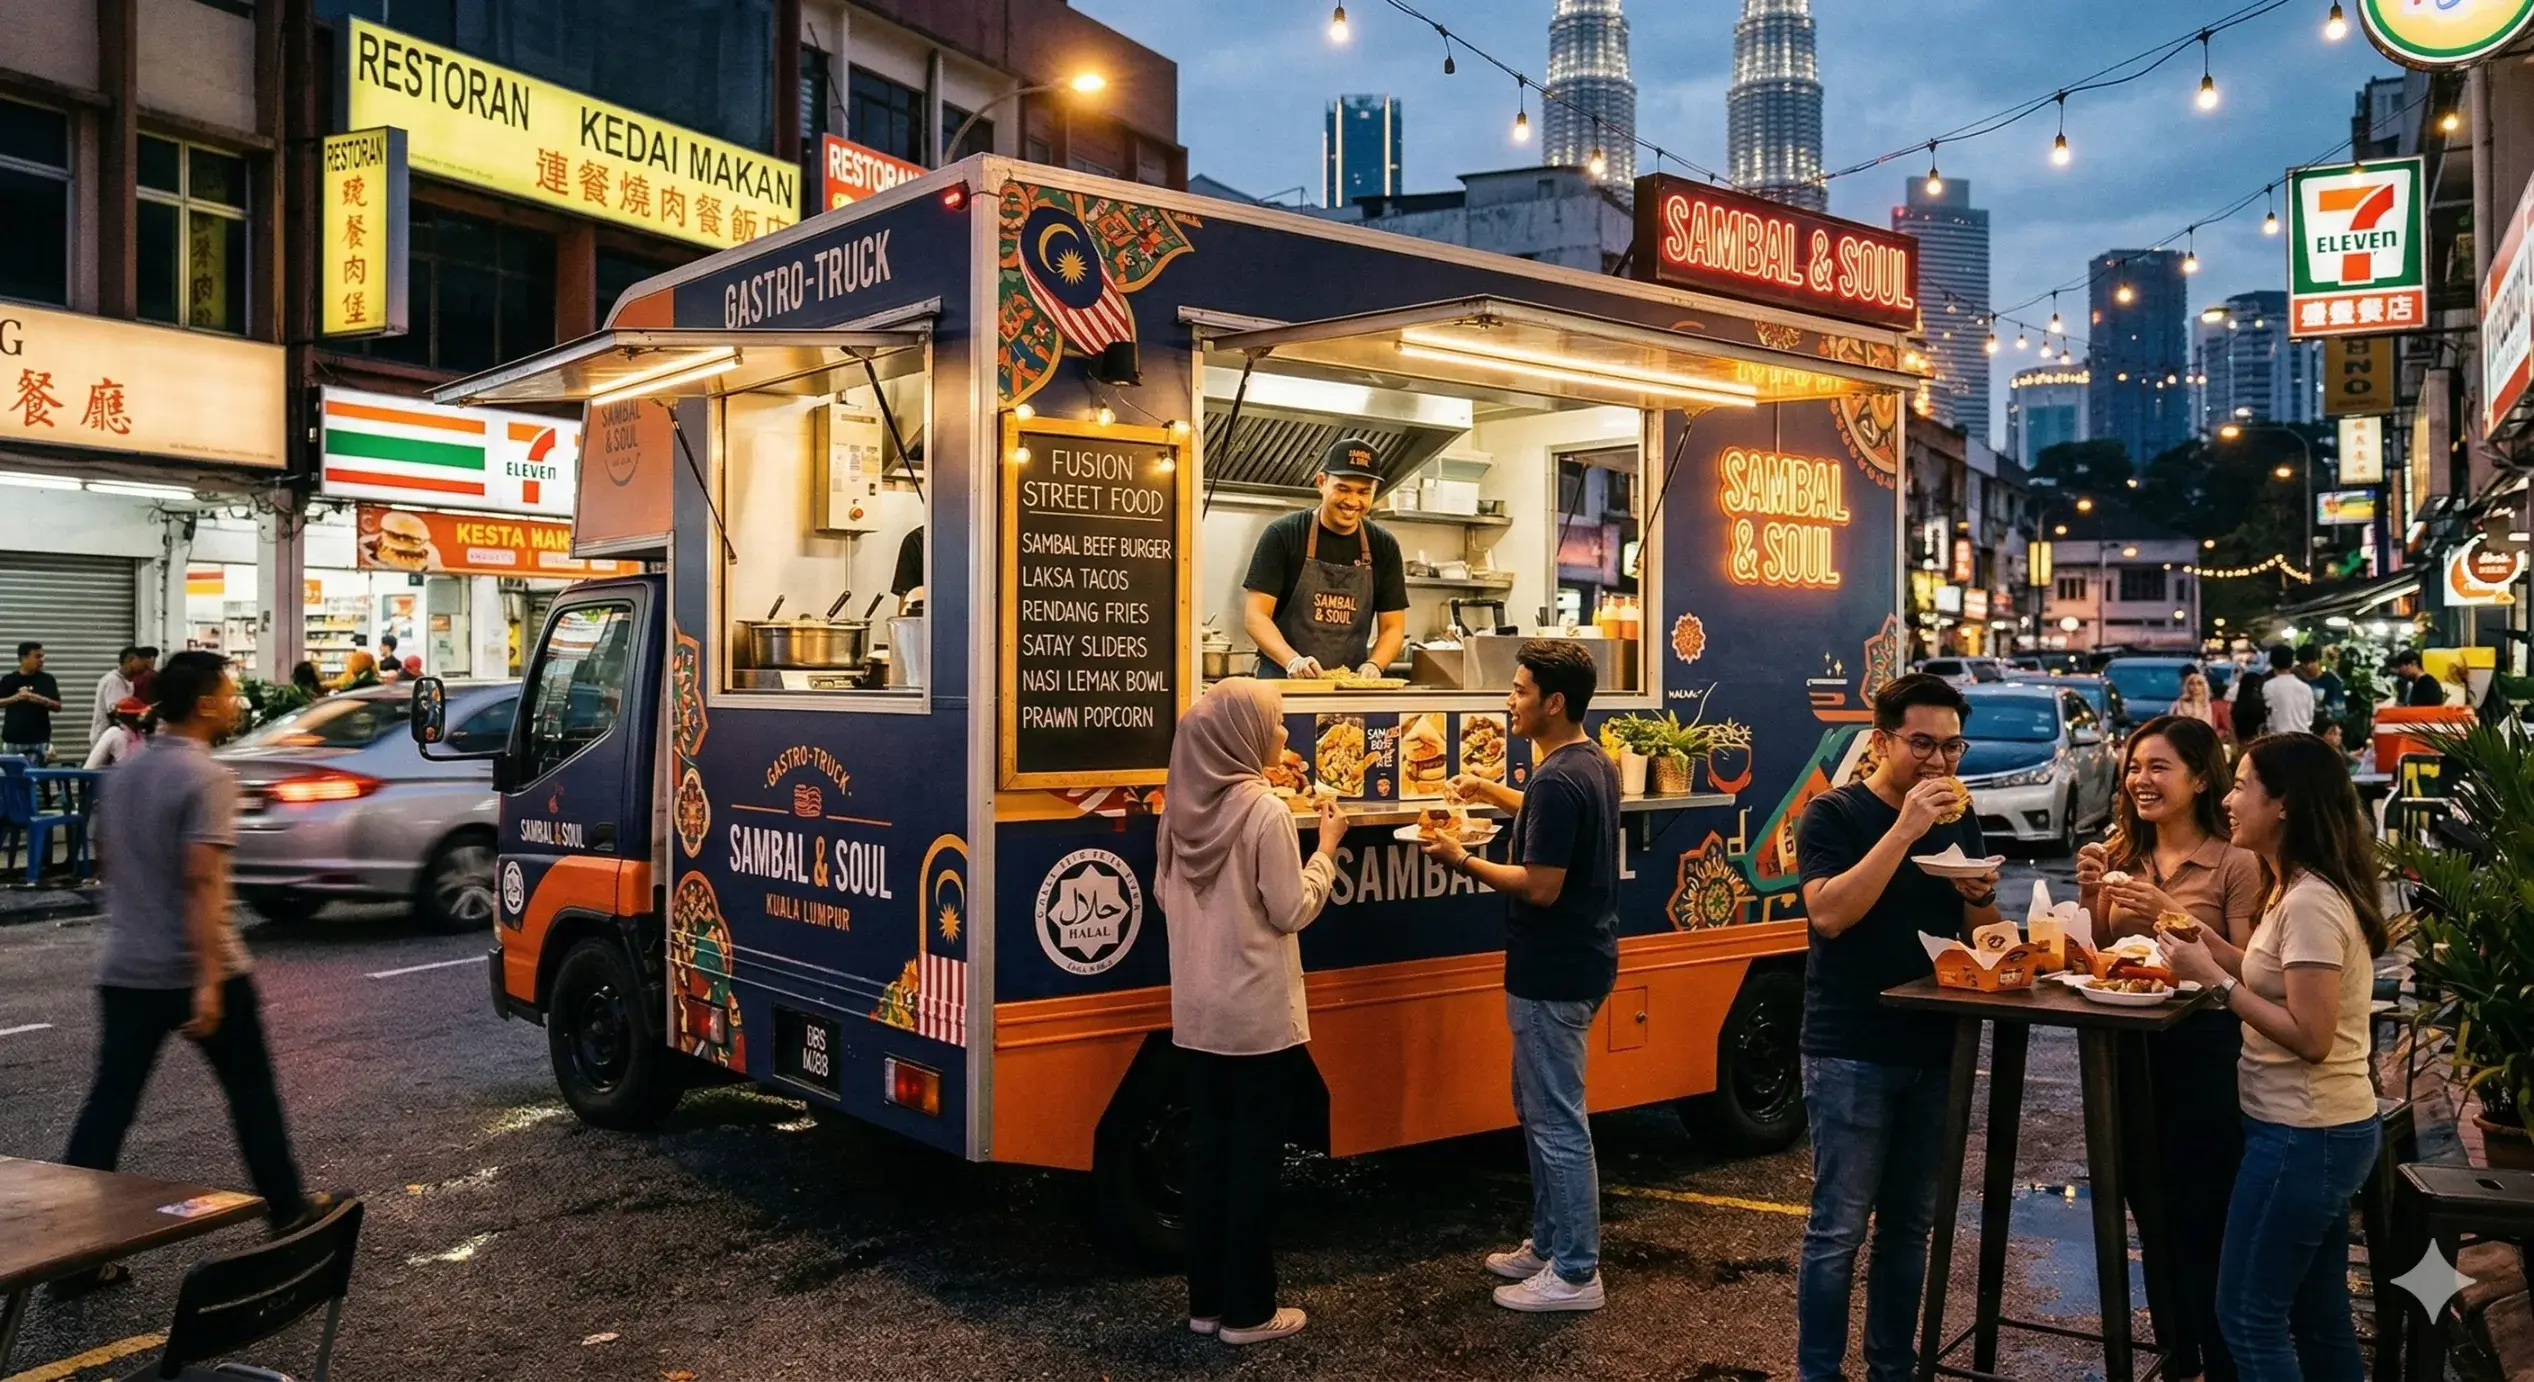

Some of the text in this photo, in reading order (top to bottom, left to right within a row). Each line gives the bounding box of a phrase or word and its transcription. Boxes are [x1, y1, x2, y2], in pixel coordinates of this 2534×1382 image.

[359, 31, 529, 131] RESTORAN
[326, 136, 384, 173] RESTORAN
[580, 106, 793, 208] KEDAI MAKAN
[2319, 183, 2394, 281] 7
[1666, 194, 1914, 310] SAMBAL & SOUL
[724, 228, 891, 330] GASTRO-TRUCK
[9, 368, 132, 435] 餐廳
[601, 398, 641, 428] SAMBAL
[605, 426, 638, 454] & SOUL
[507, 421, 556, 504] 7
[1052, 449, 1133, 481] FUSION
[1022, 480, 1164, 515] STREET FOOD
[1725, 451, 1850, 521] SAMBAL
[456, 523, 526, 549] KESTA
[1022, 532, 1172, 559] SAMBAL BEEF BURGER
[1733, 518, 1840, 584] & SOUL
[1022, 565, 1129, 590] LAKSA TACOS
[1022, 599, 1150, 624] RENDANG FRIES
[1313, 593, 1357, 612] SAMBAL
[1314, 608, 1352, 624] & SOUL
[1022, 633, 1148, 658] SATAY SLIDERS
[1022, 669, 1169, 692] NASI LEMAK BOWL
[1022, 706, 1153, 728] PRAWN POPCORN
[766, 745, 850, 796] GASTRO-TRUCK
[520, 818, 585, 848] SAMBAL & SOUL
[729, 823, 892, 899] SAMBAL & SOUL
[766, 892, 850, 932] KUALA LUMPUR
[1059, 887, 1122, 926] حلال
[1069, 926, 1111, 940] HALAL
